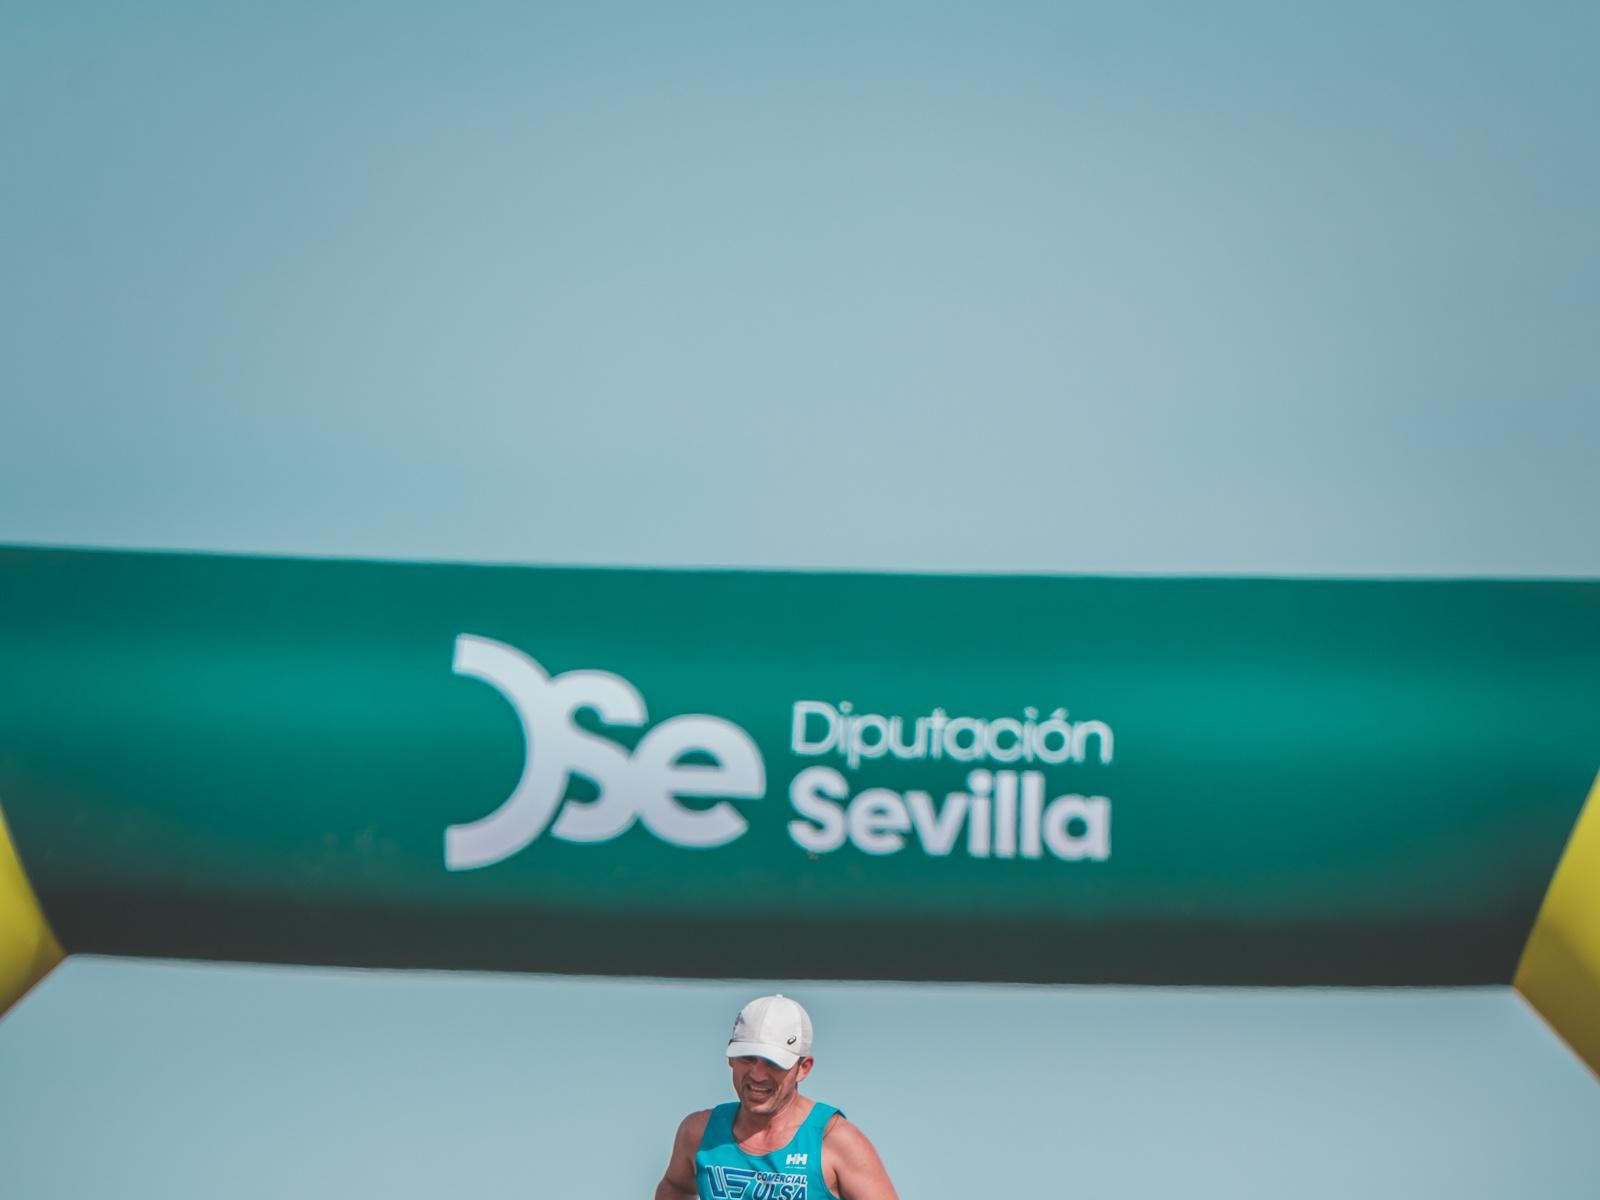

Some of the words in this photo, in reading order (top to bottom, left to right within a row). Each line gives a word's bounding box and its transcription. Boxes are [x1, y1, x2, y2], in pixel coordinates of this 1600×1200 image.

[790, 699, 1113, 768] Diputación
[788, 765, 1111, 861] Sevilla
[756, 1172, 807, 1185] COMERCIAL
